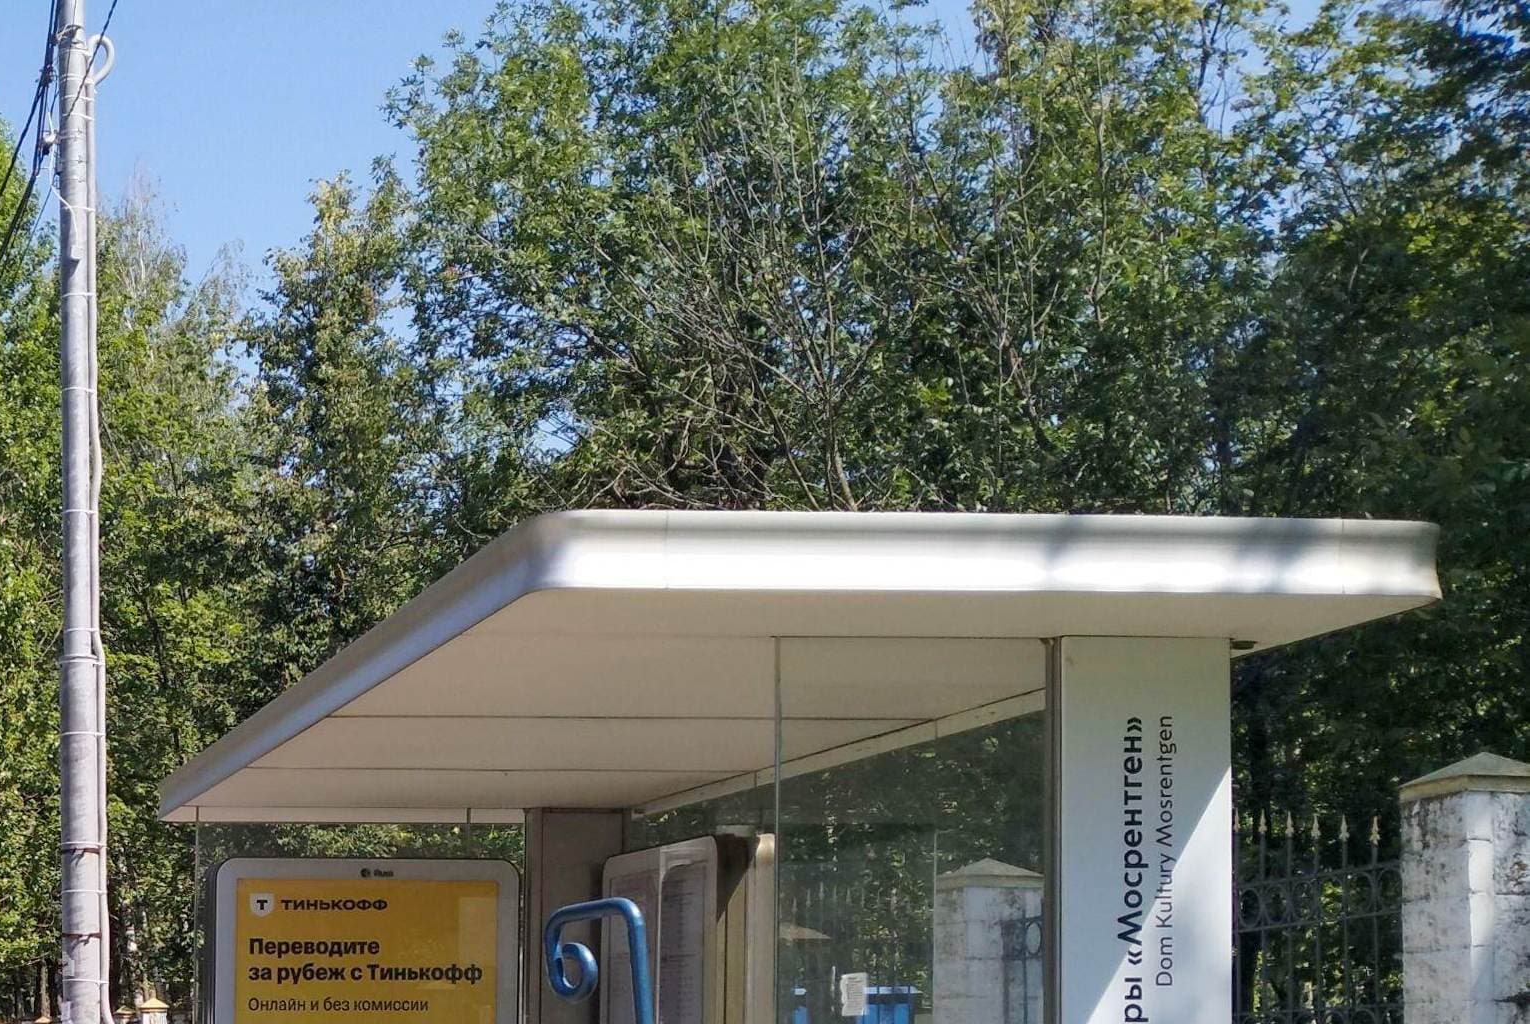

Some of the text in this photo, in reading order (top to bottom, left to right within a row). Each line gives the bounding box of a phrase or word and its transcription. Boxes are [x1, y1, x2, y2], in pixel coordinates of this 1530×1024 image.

[1117, 716, 1150, 966] «Мосрентген»
[1154, 716, 1178, 987] Dom Kultury Mosrentgen
[280, 899, 388, 911] ТИНЬКОФФ
[249, 938, 380, 959] Переводите
[248, 963, 483, 985] за рубеж с Тинькофф
[248, 997, 429, 1012] Онлайн и без комиссии
